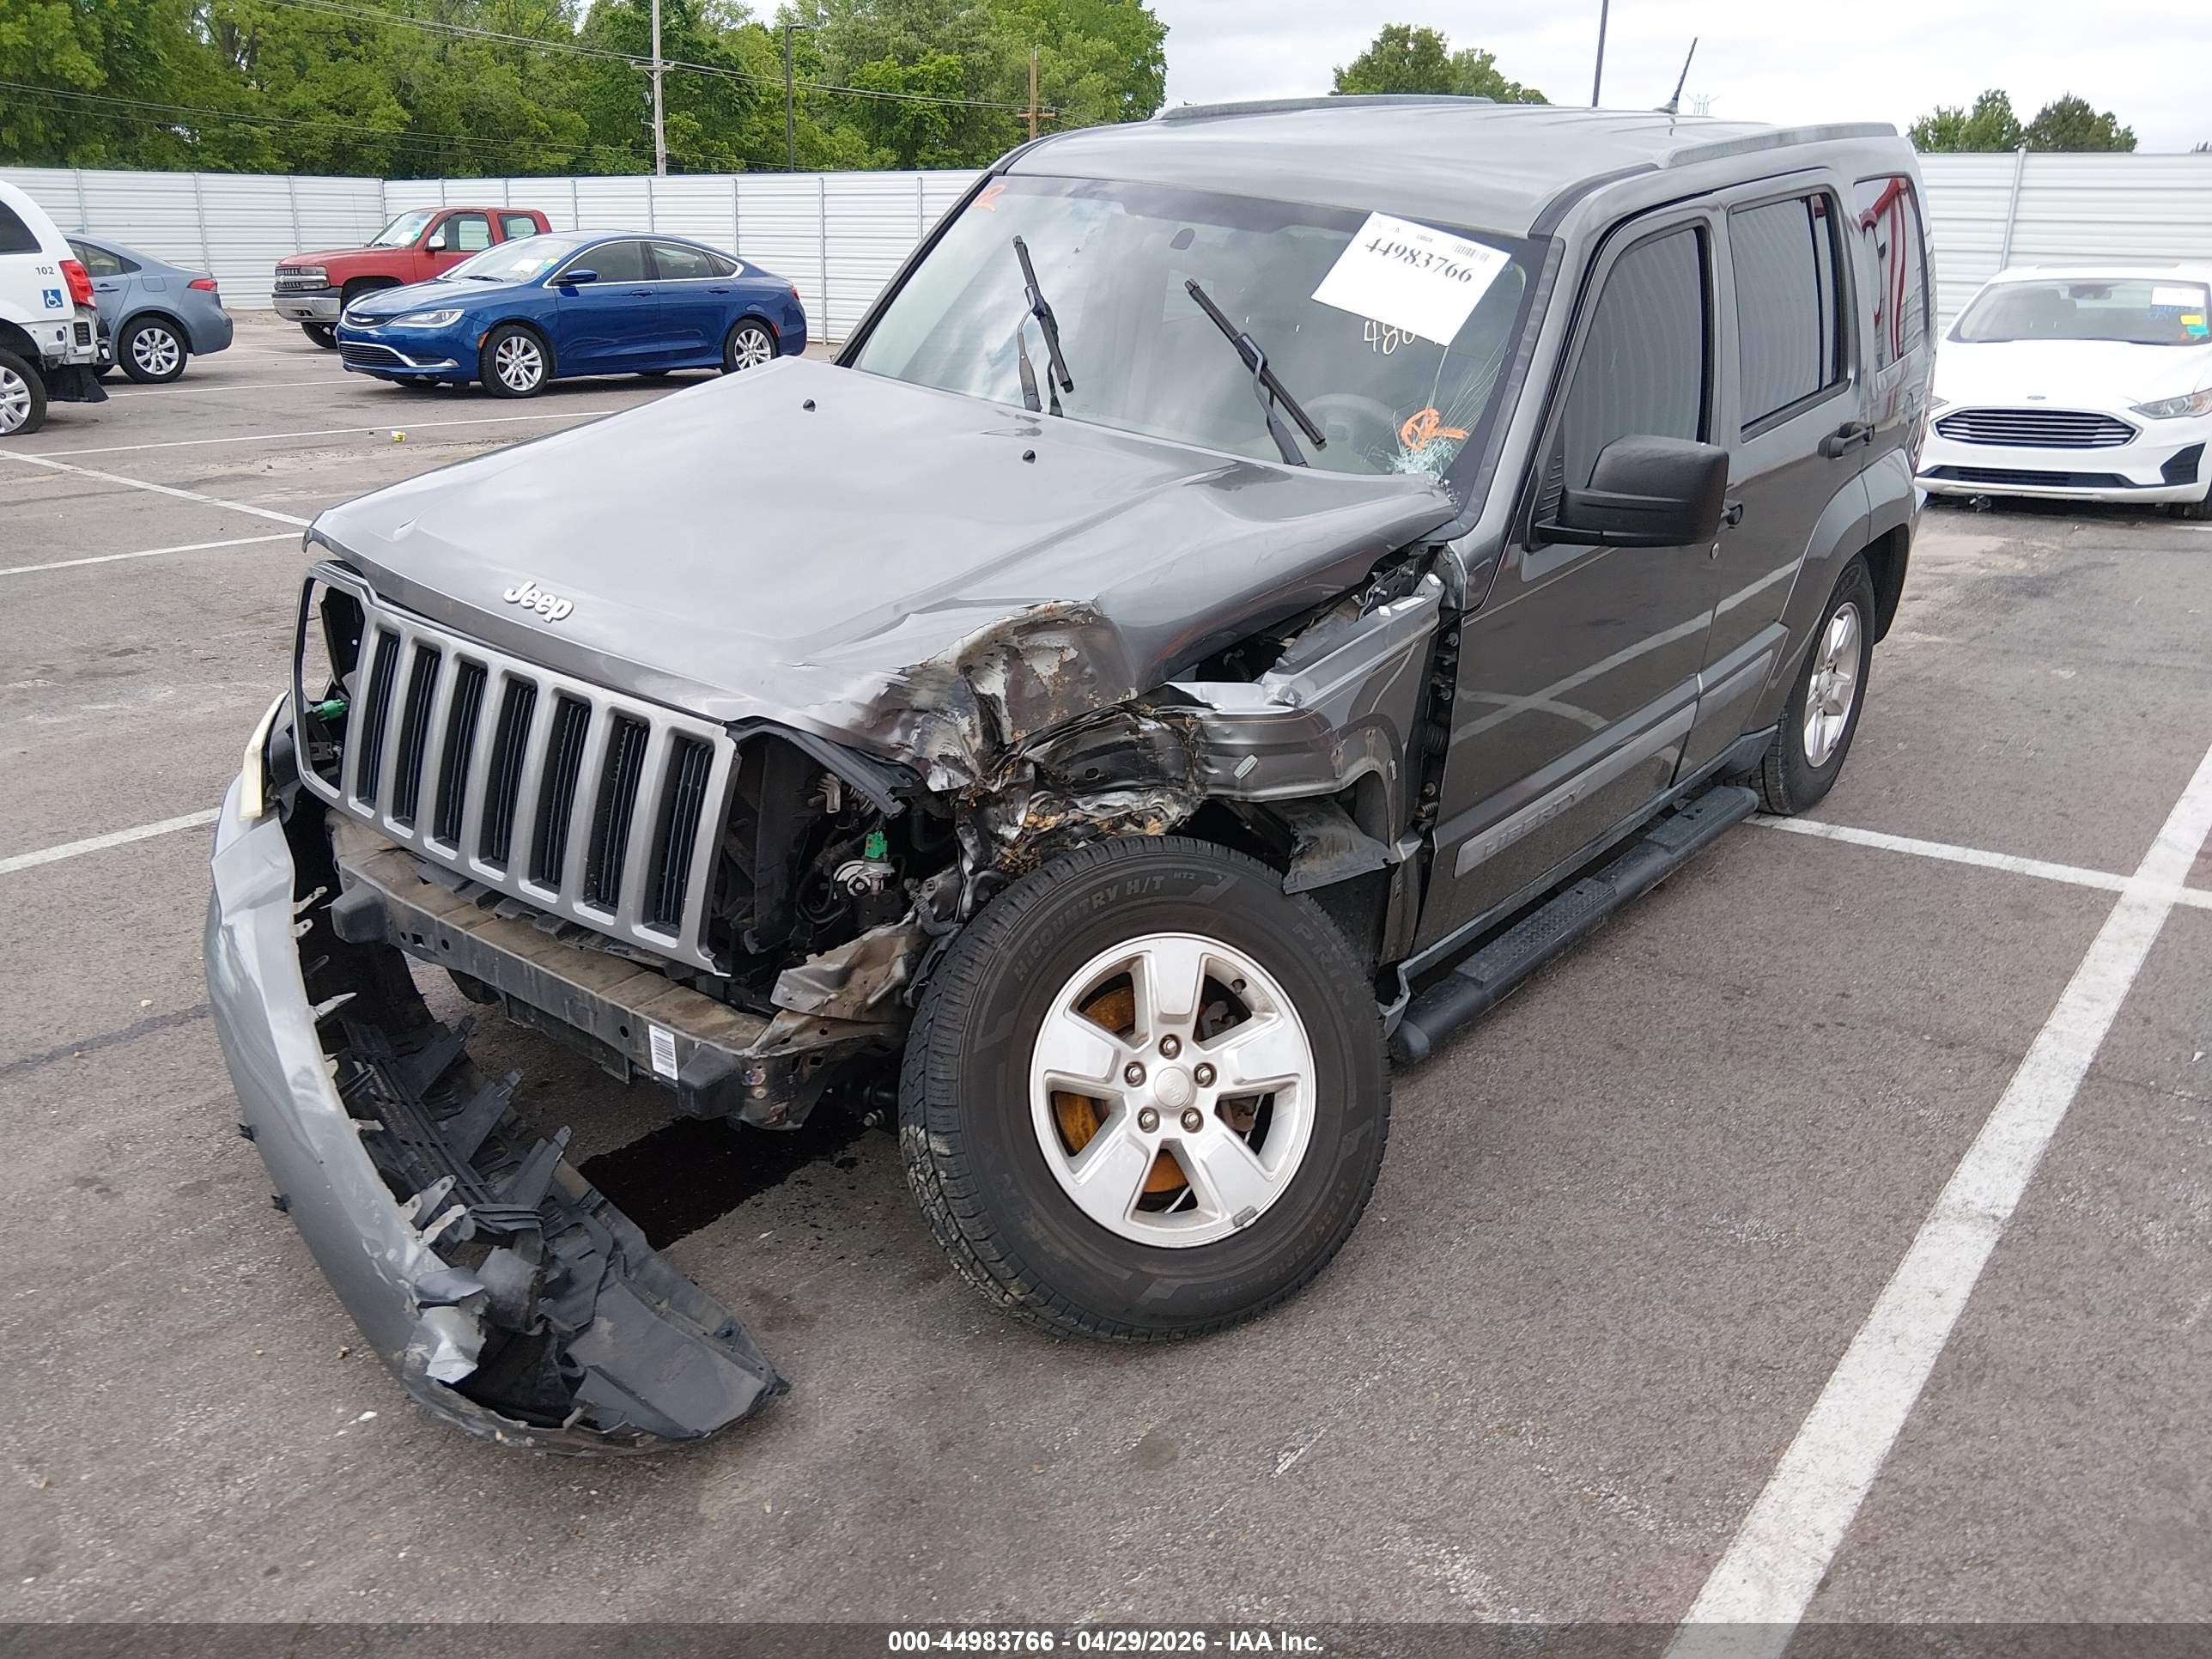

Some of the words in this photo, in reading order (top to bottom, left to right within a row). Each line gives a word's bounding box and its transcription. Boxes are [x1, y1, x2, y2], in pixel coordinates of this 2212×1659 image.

[35, 266, 55, 276] 102
[1364, 237, 1476, 283] 44983766
[503, 580, 574, 623] Jeep
[1126, 874, 1166, 896] H/T
